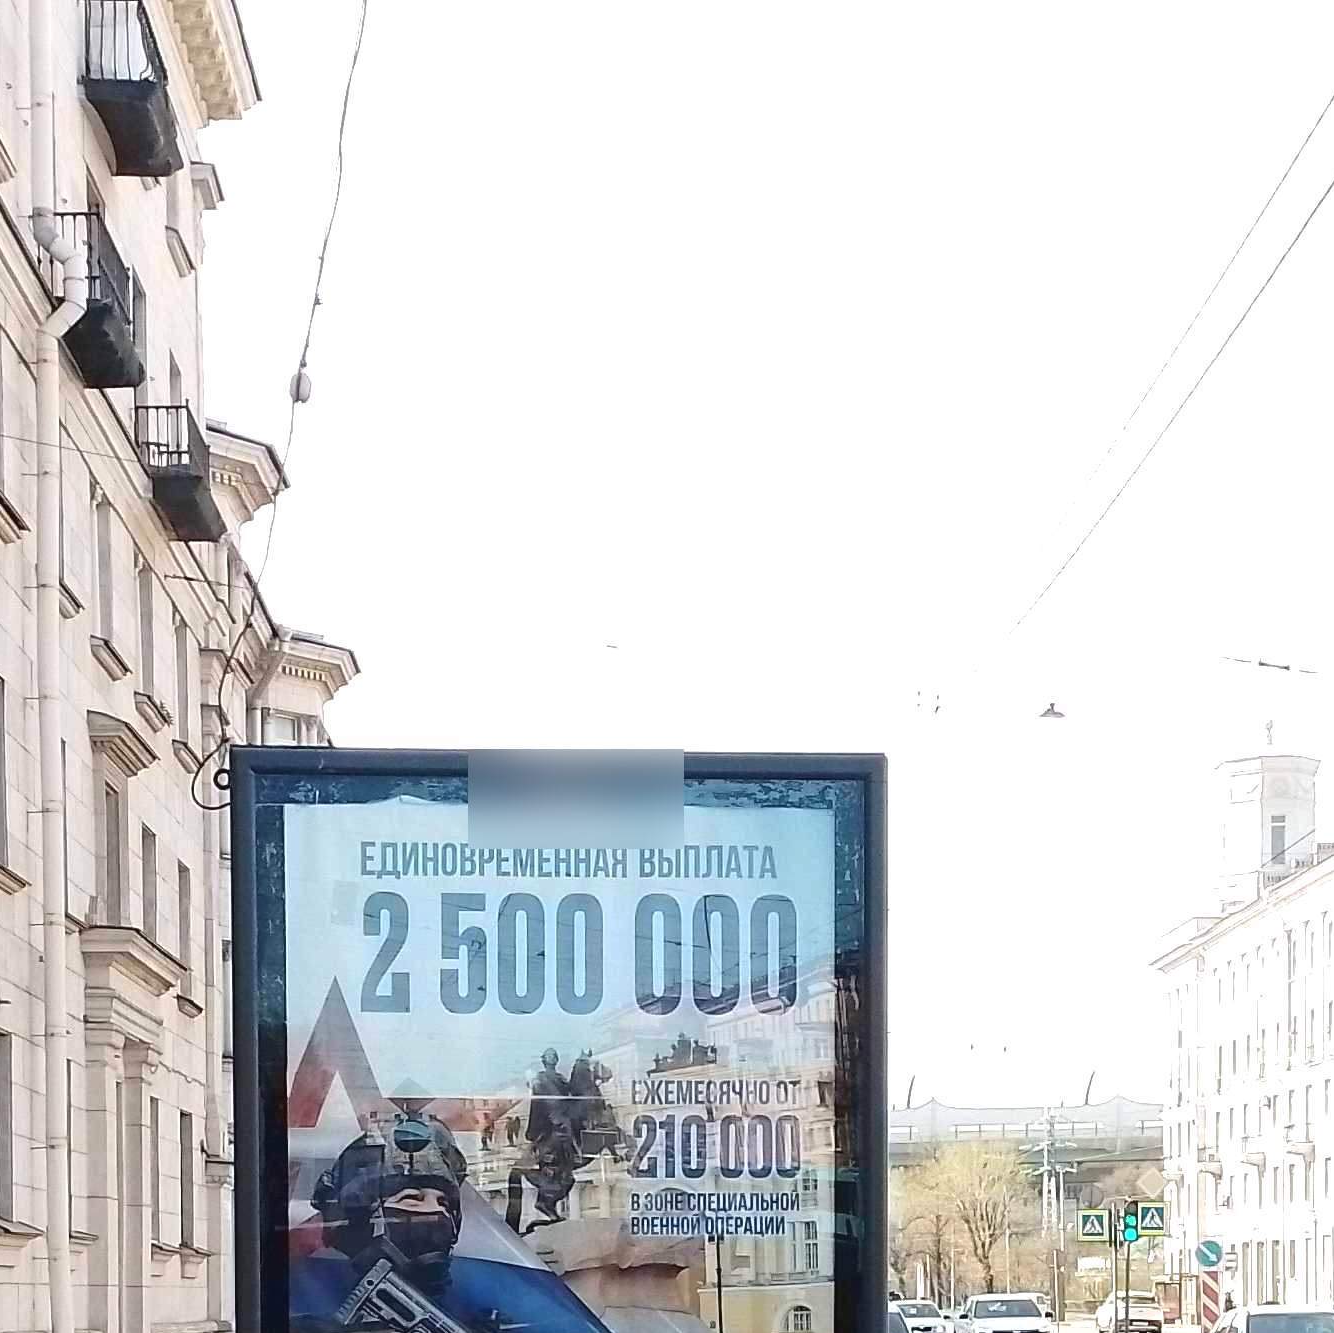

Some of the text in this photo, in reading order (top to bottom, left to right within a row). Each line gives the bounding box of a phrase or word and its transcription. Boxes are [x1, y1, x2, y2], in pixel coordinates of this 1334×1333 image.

[360, 841, 778, 879] ЕДИНОВРЕМЕННАЯ ВЫПЛАТА
[631, 1080, 801, 1105] ЕЖЕМЕСЯЧНО ОТ
[631, 1189, 800, 1213] В ЗОНЕ СПЕЦИАЛЬНОЙ
[631, 1213, 786, 1239] ВОЕННОЙ ОПЕРАЦИИ
